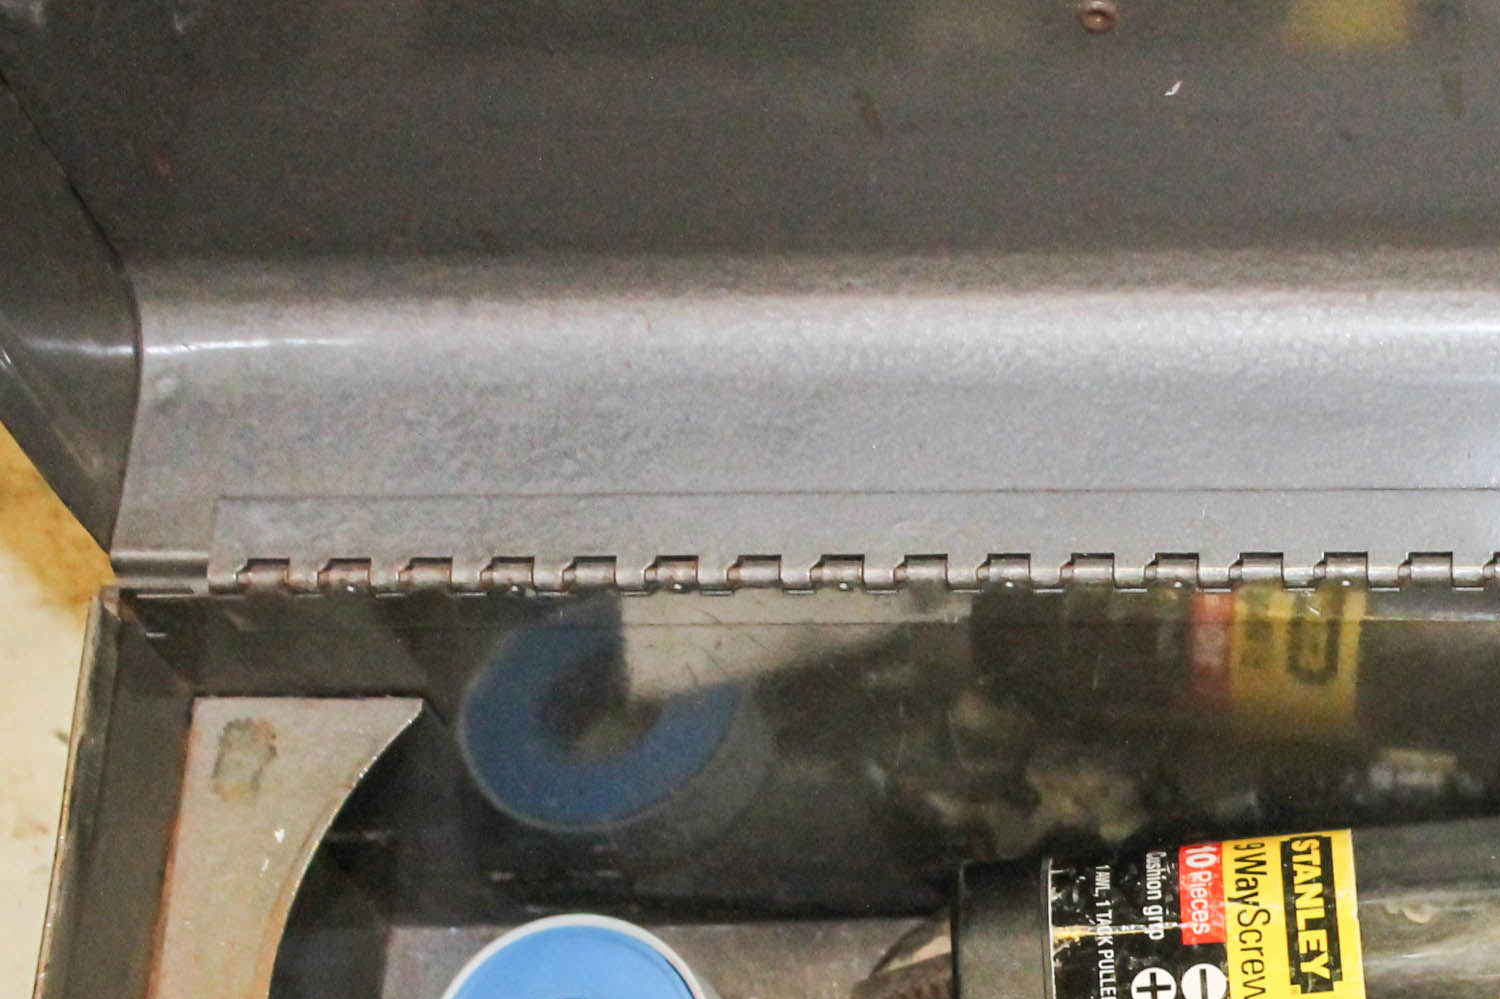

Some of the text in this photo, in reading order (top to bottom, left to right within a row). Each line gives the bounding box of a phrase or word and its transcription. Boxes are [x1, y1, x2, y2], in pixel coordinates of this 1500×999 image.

[1145, 852, 1167, 901] Cushion
[1185, 845, 1221, 936] 10 Pieces
[1227, 851, 1269, 907] Way
[1095, 909, 1114, 946] TACK
[1291, 837, 1331, 980] STANLEY
